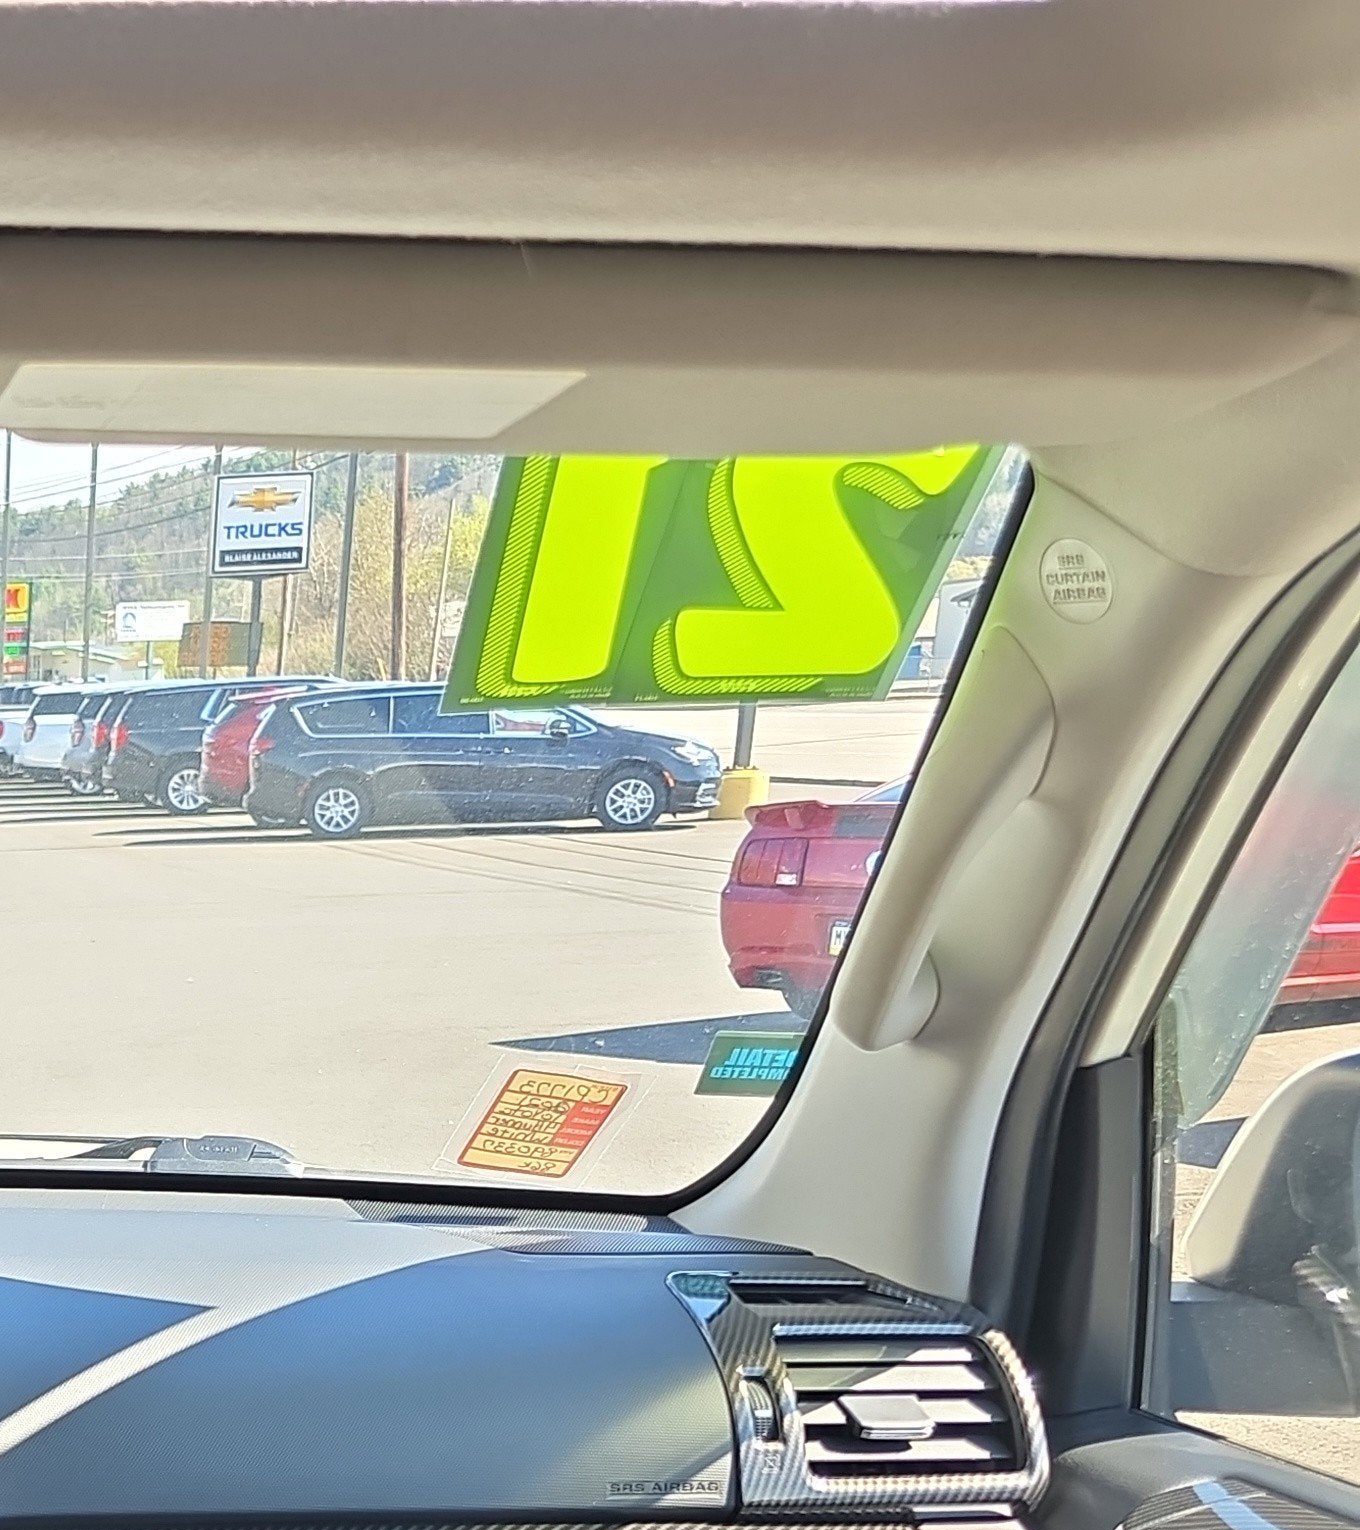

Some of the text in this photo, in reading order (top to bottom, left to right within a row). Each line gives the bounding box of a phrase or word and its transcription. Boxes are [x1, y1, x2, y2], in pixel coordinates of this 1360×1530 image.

[223, 522, 303, 539] TRUCKS
[1046, 570, 1106, 585] CURTAIN
[1053, 586, 1106, 601] AIRBAG
[609, 1482, 719, 1493] SRS AIRBAG
